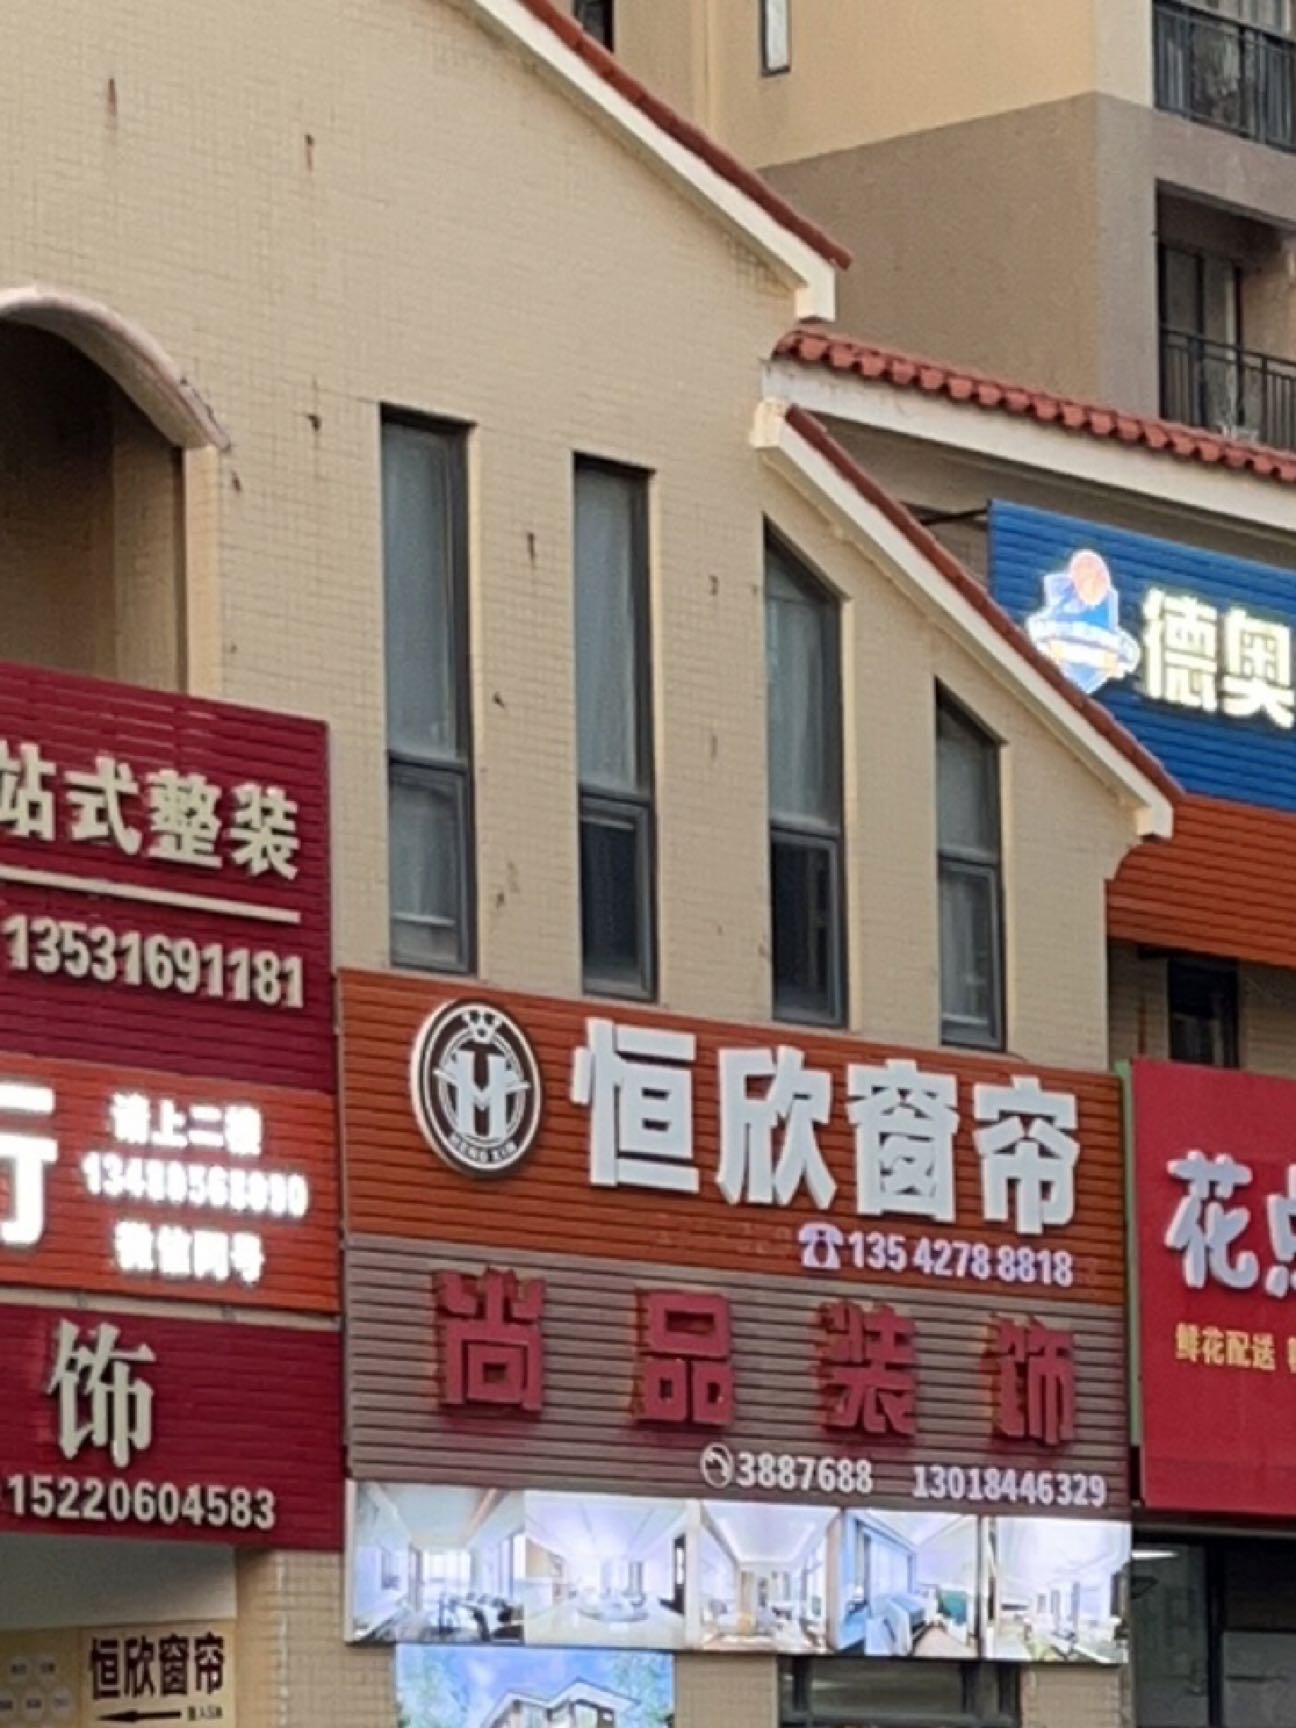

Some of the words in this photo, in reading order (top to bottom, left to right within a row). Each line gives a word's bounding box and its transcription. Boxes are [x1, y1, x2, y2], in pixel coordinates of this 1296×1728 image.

[0, 739, 299, 880] 站式整装
[4, 913, 303, 1009] 13531691181
[570, 1018, 1080, 1235] 恒欣窗帘
[47, 1318, 157, 1469] 饰
[430, 1266, 1076, 1447] 尚品装饰
[1175, 1322, 1276, 1371] 鲜花配送
[7, 1474, 276, 1530] 15220604583
[735, 1450, 874, 1495] 3887688
[913, 1463, 1107, 1508] 13018446329
[88, 1631, 224, 1700] 恒欣窗帘
